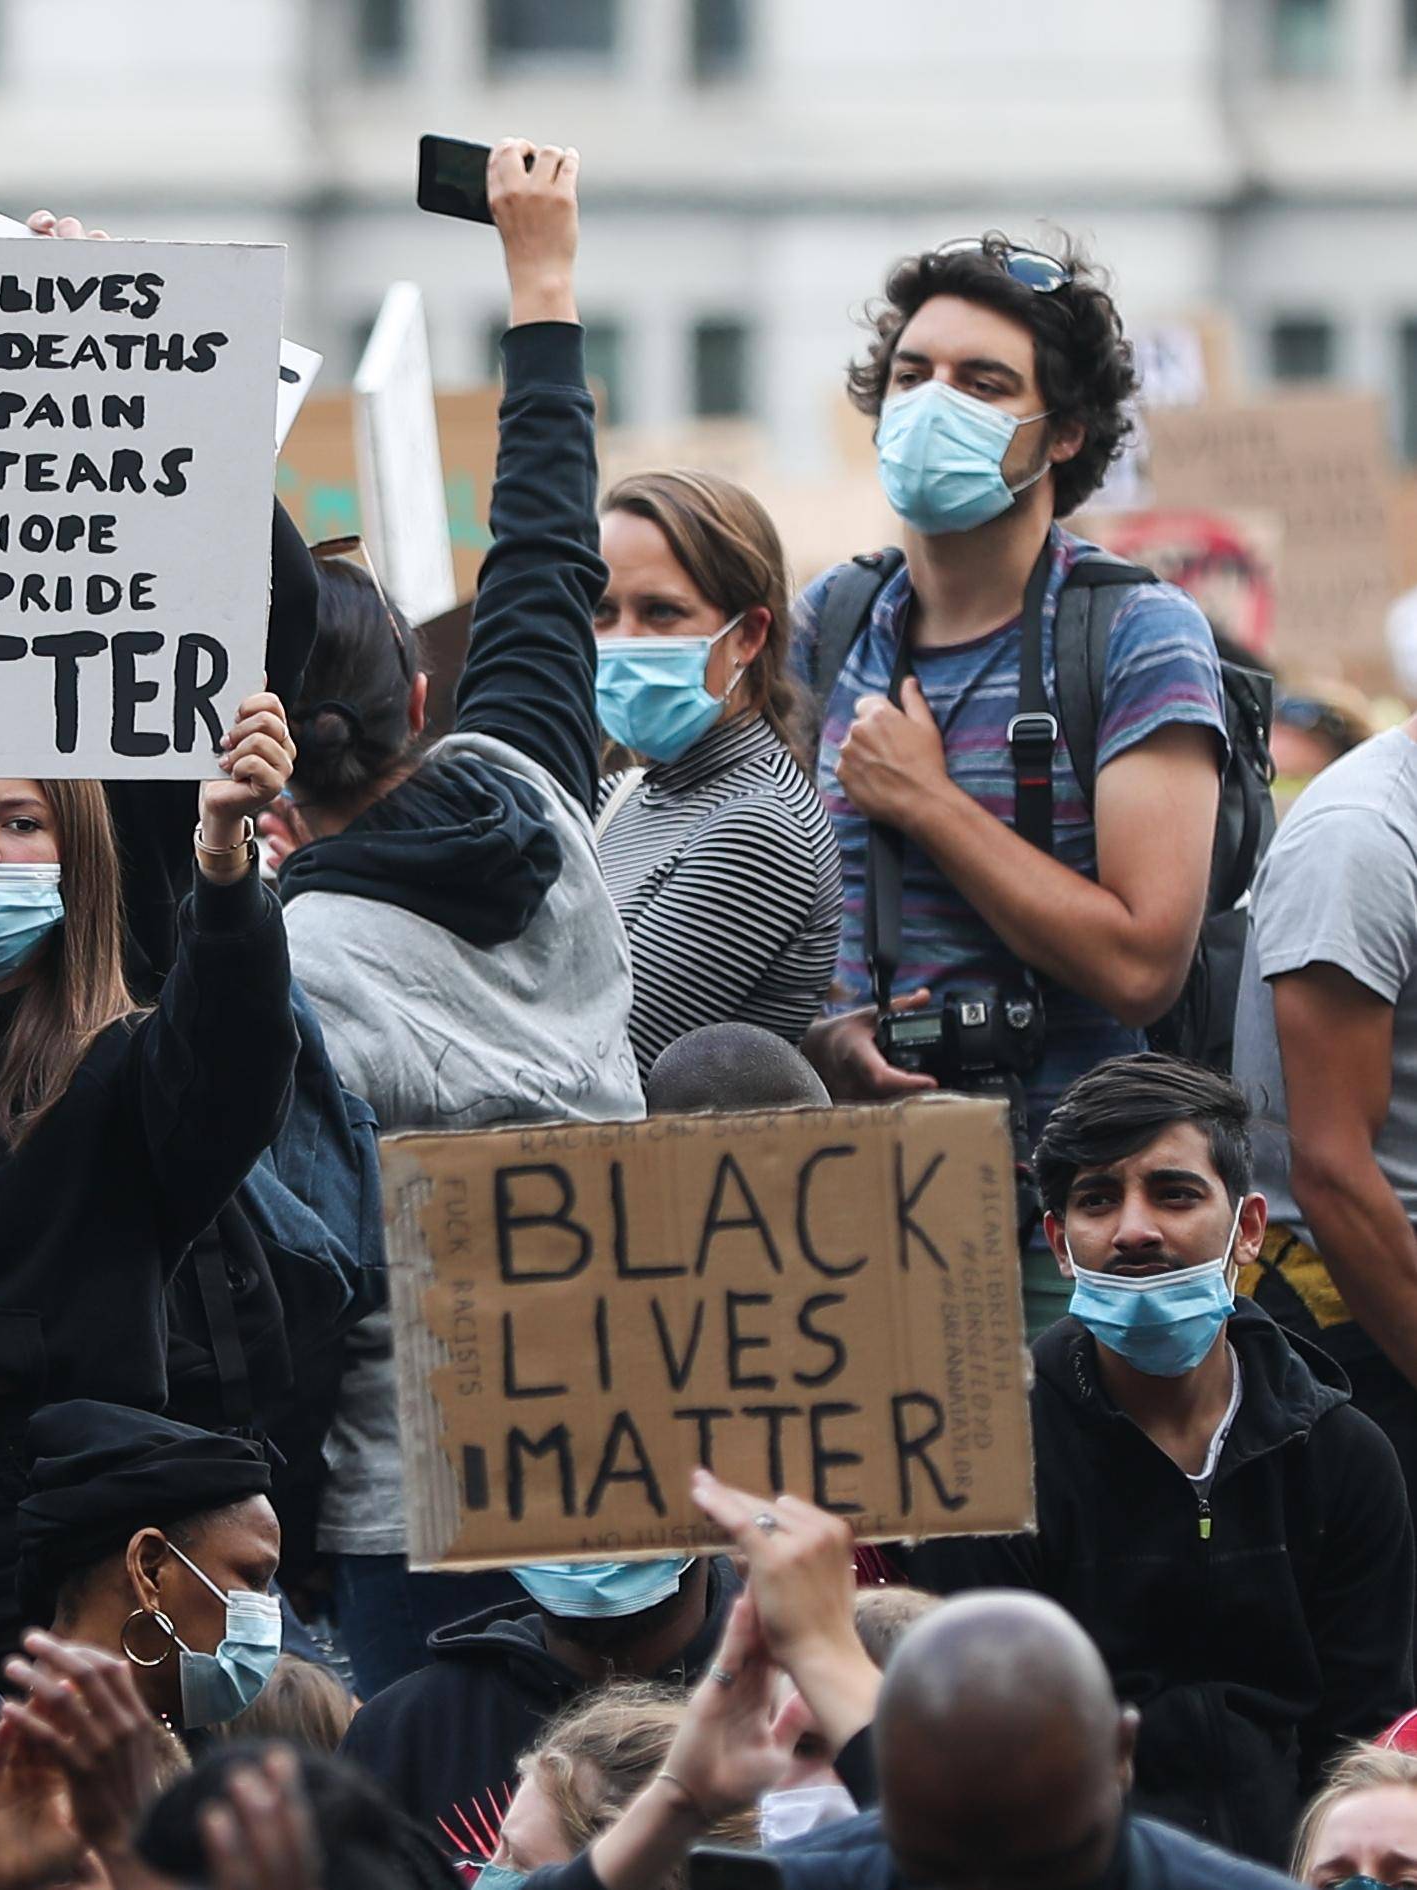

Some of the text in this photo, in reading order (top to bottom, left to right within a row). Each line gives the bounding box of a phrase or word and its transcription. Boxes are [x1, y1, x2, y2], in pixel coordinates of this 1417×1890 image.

[519, 1122, 637, 1154] RACISM
[494, 1141, 950, 1286] BLACK
[443, 1177, 482, 1397] FUCK RACISTS
[501, 1290, 848, 1400] LIVES
[504, 1389, 970, 1522] MATTER
[633, 1521, 732, 1547] JUSTIC
